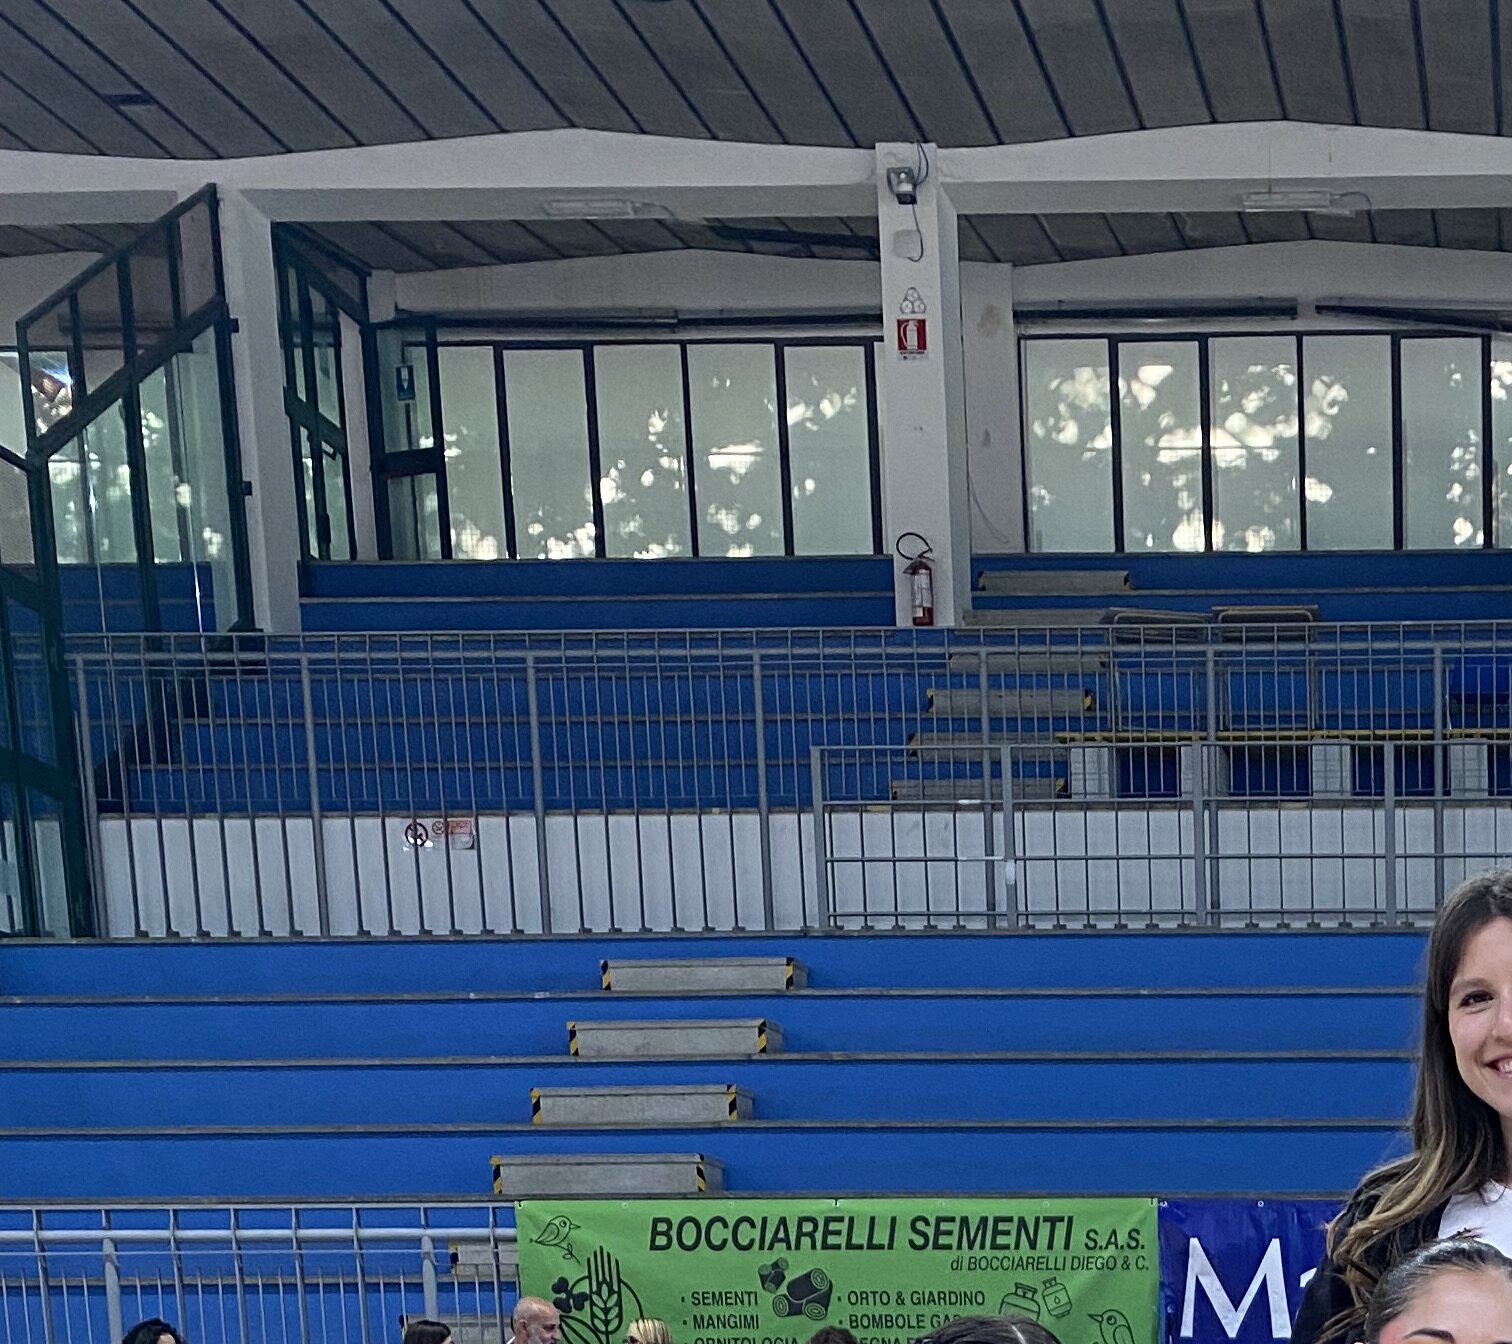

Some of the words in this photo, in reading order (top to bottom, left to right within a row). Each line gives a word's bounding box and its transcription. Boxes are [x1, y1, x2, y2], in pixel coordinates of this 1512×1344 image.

[648, 1214, 898, 1252] BOCCIARELLI
[907, 1214, 1074, 1251] SEMENTI
[1083, 1228, 1146, 1251] S.A.S.
[951, 1254, 963, 1272] di
[967, 1254, 1067, 1271] BOCCIARELLI
[1070, 1254, 1117, 1271] DIEGO
[1120, 1254, 1131, 1271] &
[1134, 1254, 1150, 1271] C.
[690, 1290, 759, 1307] SEMENTI
[847, 1290, 891, 1306] ORTO
[895, 1290, 906, 1306] &
[910, 1289, 986, 1306] GIARDINO
[692, 1314, 760, 1330] MANGIMI
[848, 1313, 926, 1330] BOMBOLE
